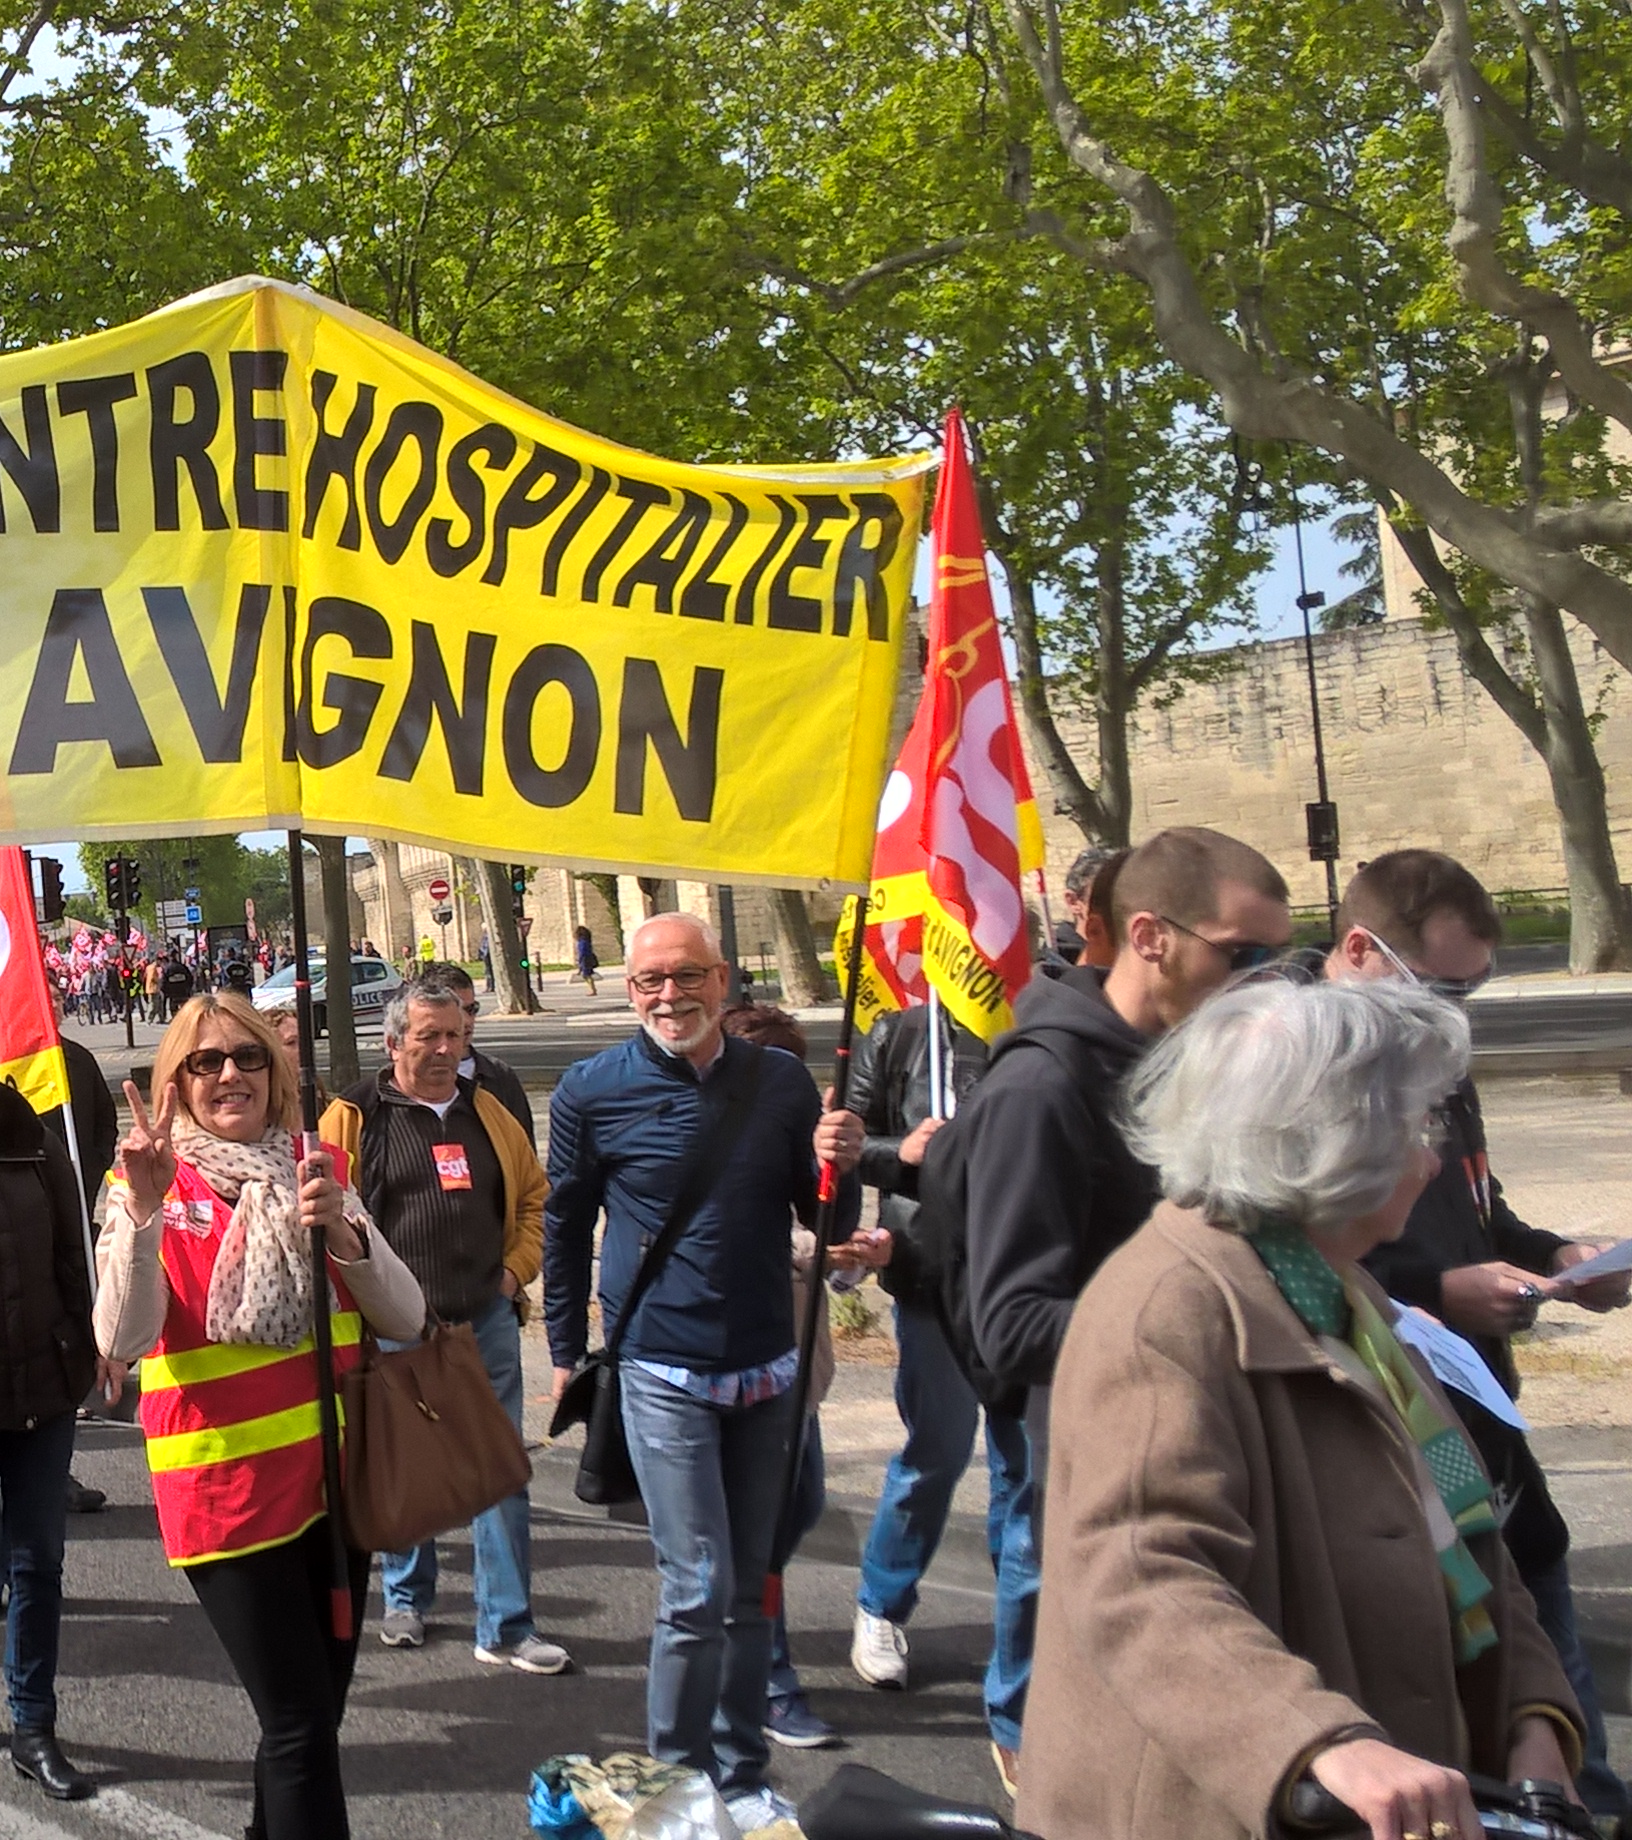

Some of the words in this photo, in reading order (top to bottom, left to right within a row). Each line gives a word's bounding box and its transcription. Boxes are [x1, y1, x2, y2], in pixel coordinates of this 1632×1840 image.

[301, 368, 904, 643] HOSPITALIER
[9, 583, 725, 823] AVIGNON
[352, 991, 384, 1005] OLICE
